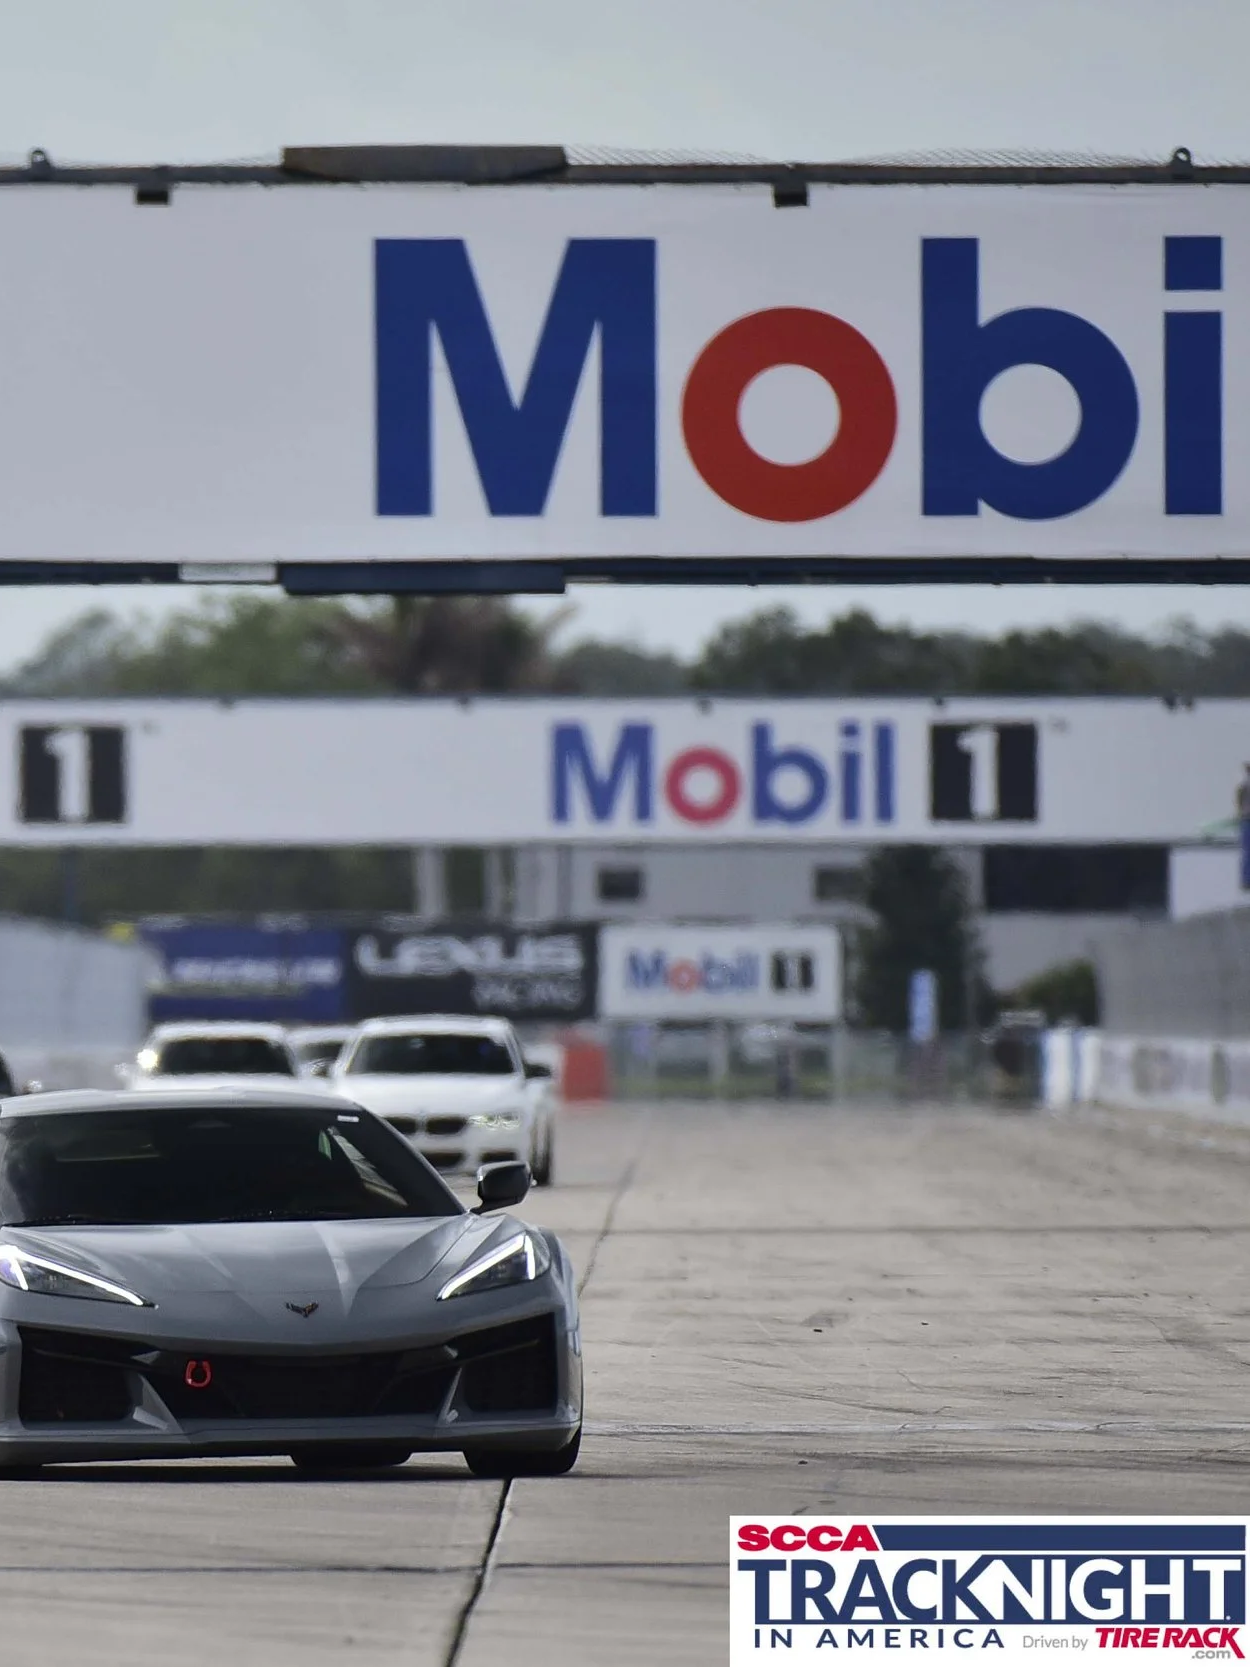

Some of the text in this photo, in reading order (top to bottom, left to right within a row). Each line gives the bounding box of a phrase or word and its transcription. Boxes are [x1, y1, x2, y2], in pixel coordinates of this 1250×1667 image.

[551, 721, 895, 826] Mobil
[356, 934, 584, 977] LEXUS
[624, 948, 760, 994] Mobil
